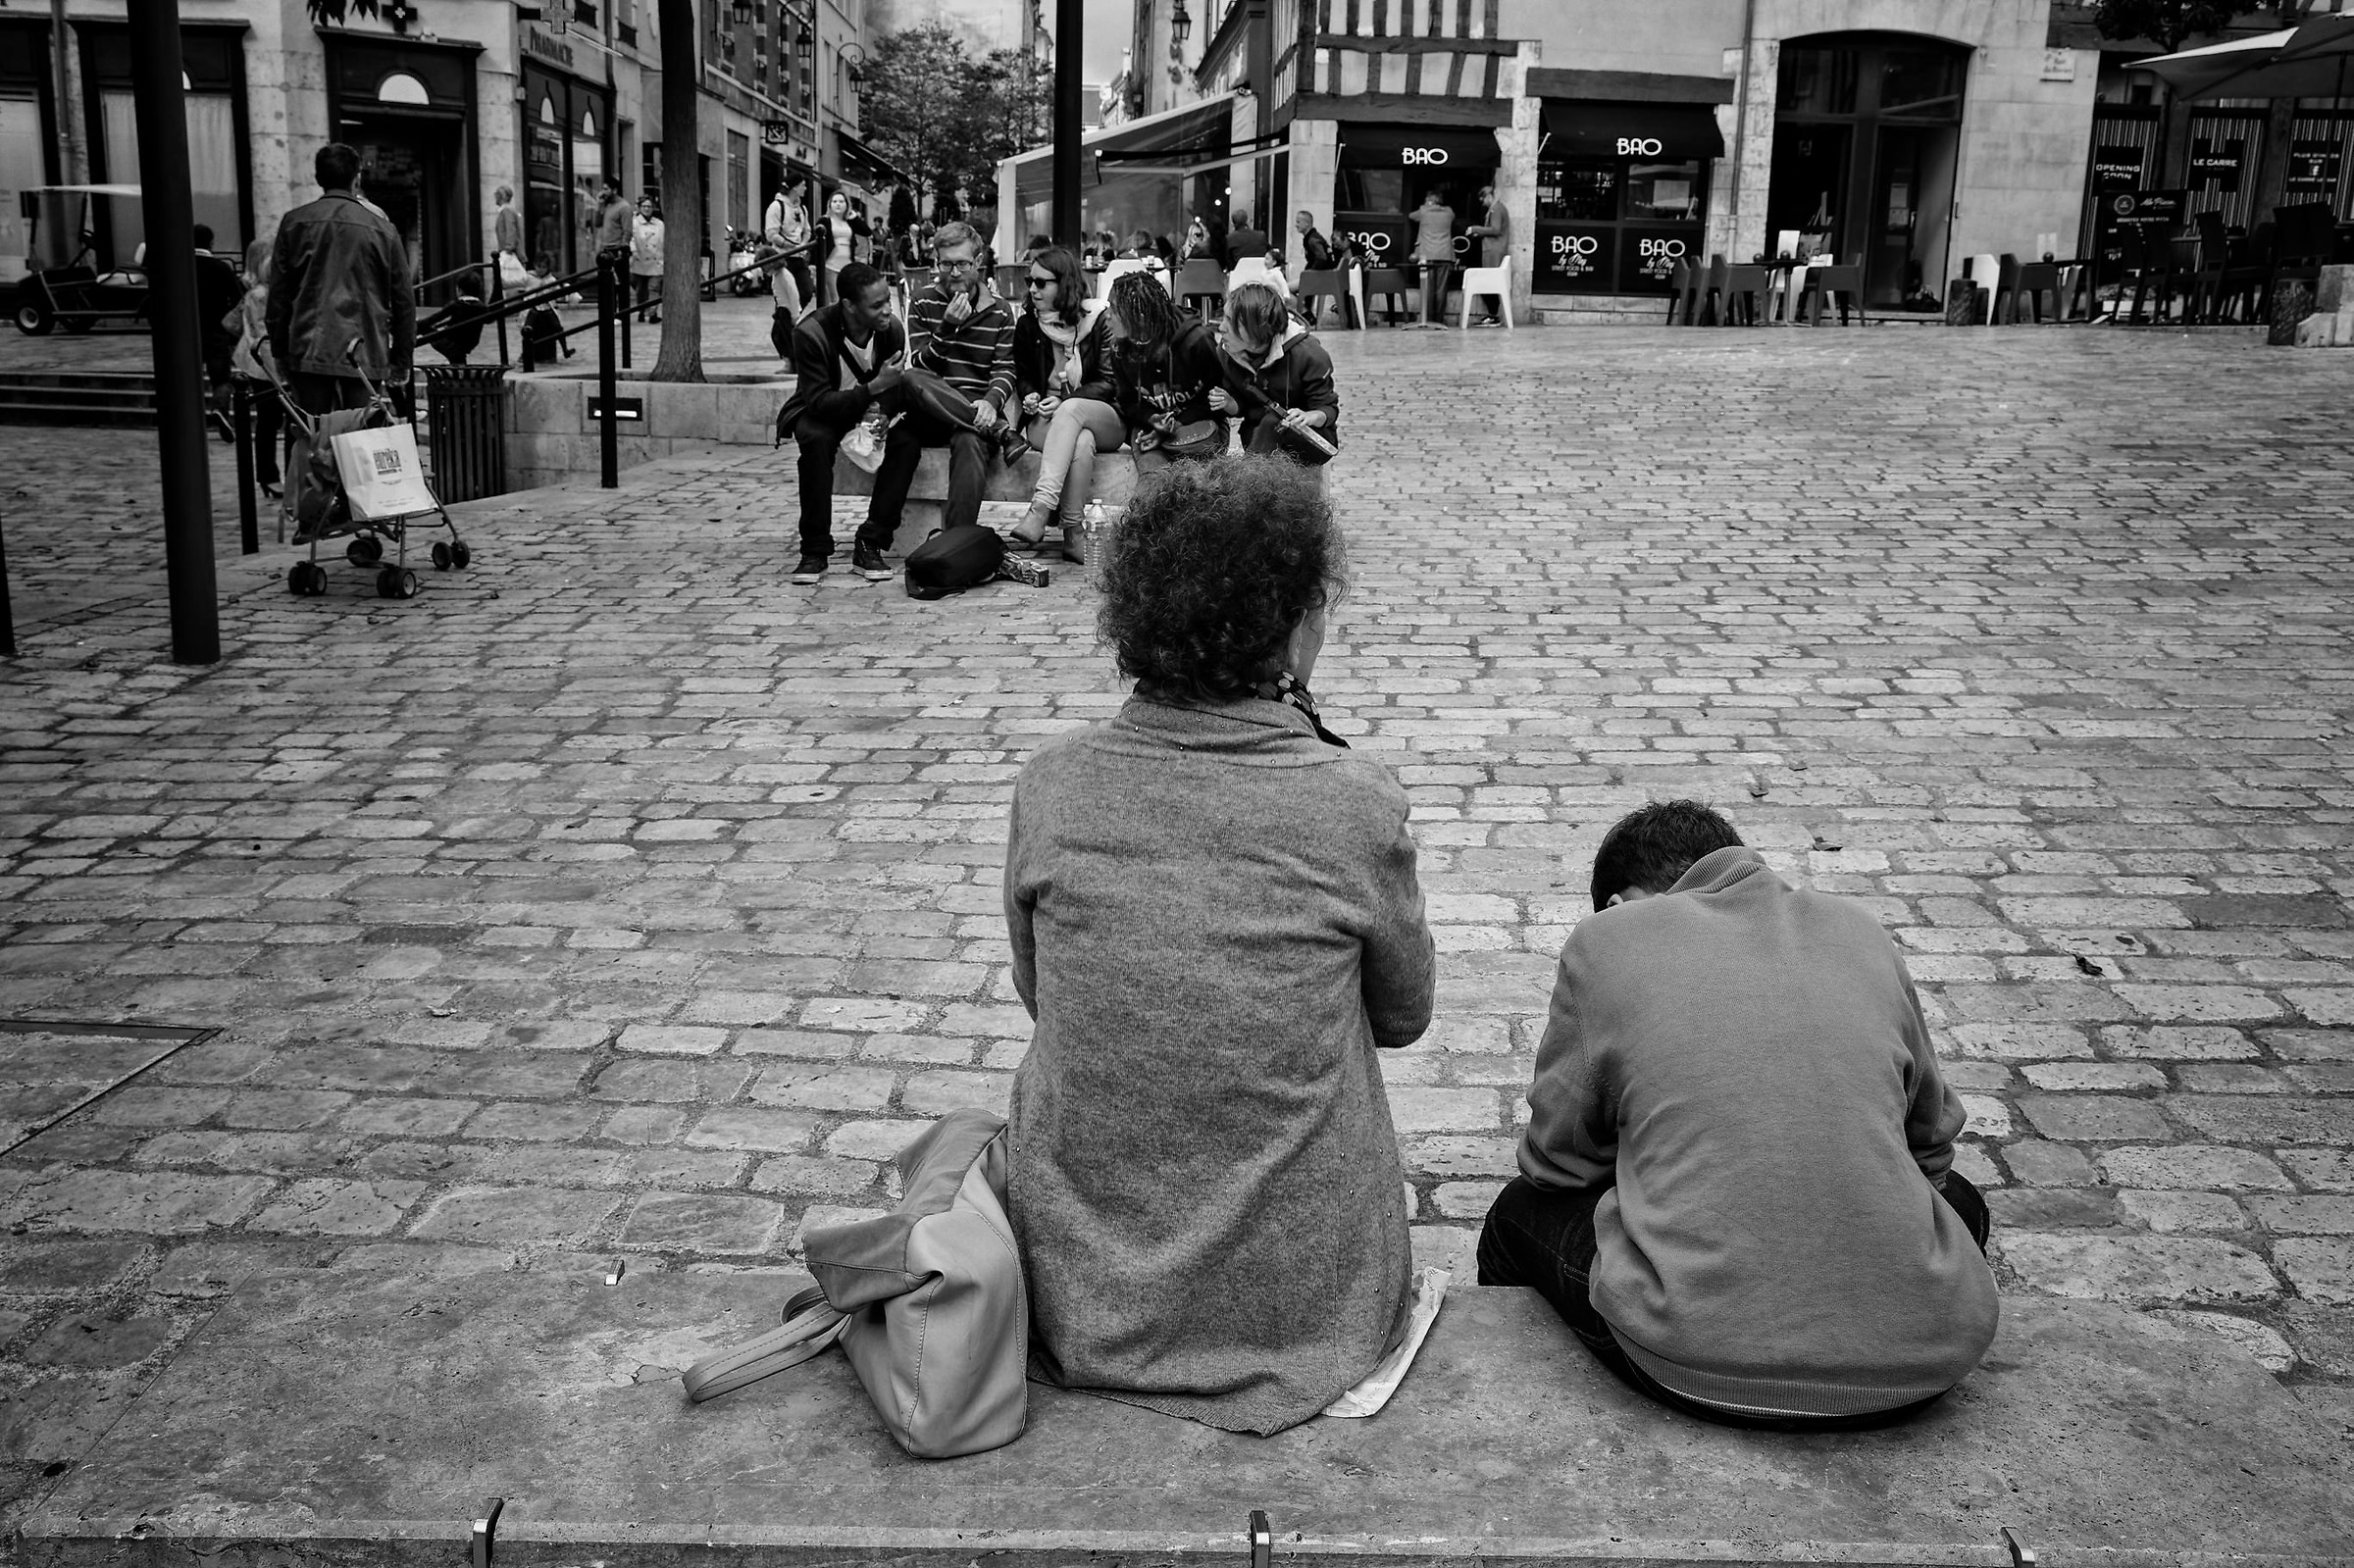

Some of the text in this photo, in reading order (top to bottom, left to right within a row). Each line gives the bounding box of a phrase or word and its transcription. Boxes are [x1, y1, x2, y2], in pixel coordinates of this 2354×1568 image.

[1402, 147, 1449, 165] BAO
[1615, 137, 1663, 156] BAO
[2095, 163, 2141, 173] OPENING
[1551, 235, 1598, 254] BAO
[1639, 238, 1686, 257] BAO
